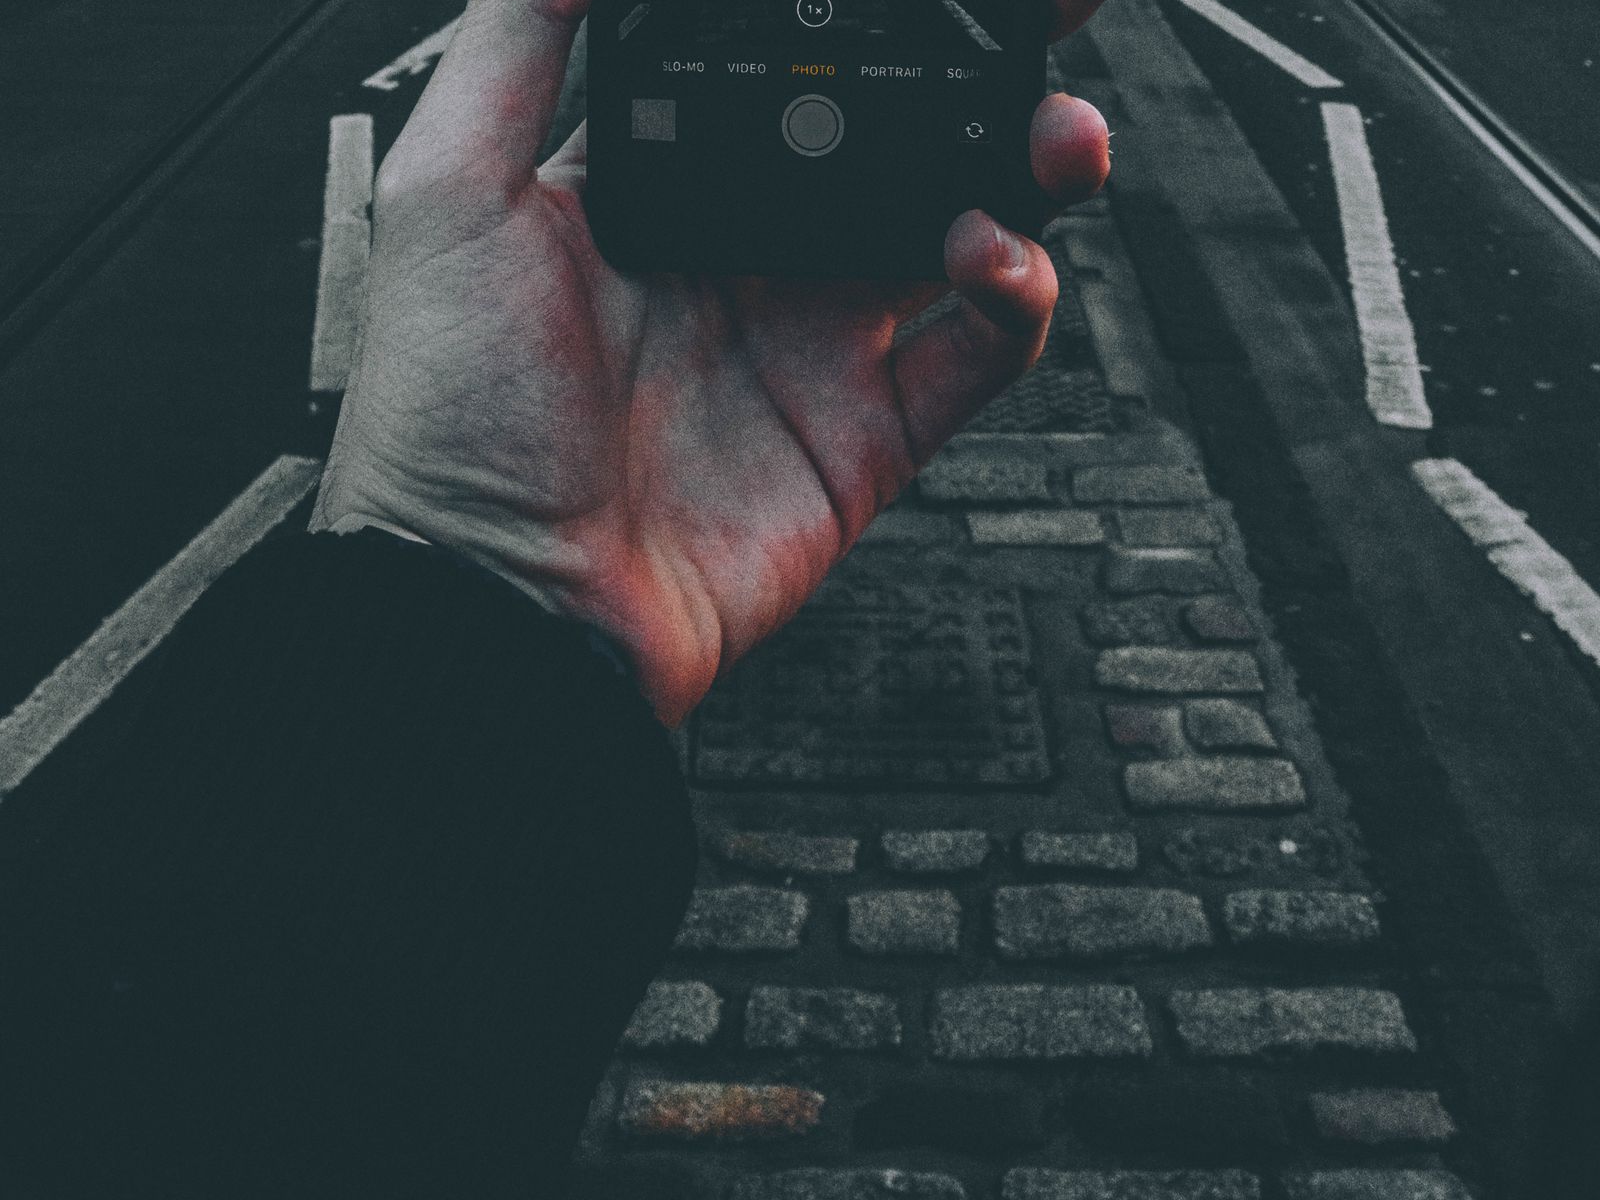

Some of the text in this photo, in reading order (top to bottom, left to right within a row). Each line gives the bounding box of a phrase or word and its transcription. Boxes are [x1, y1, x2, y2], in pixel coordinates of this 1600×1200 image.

[662, 60, 705, 73] SLO-MO
[727, 62, 767, 74] VIDEO
[791, 64, 836, 77] PHOTO
[861, 65, 923, 78] PORTRAIT
